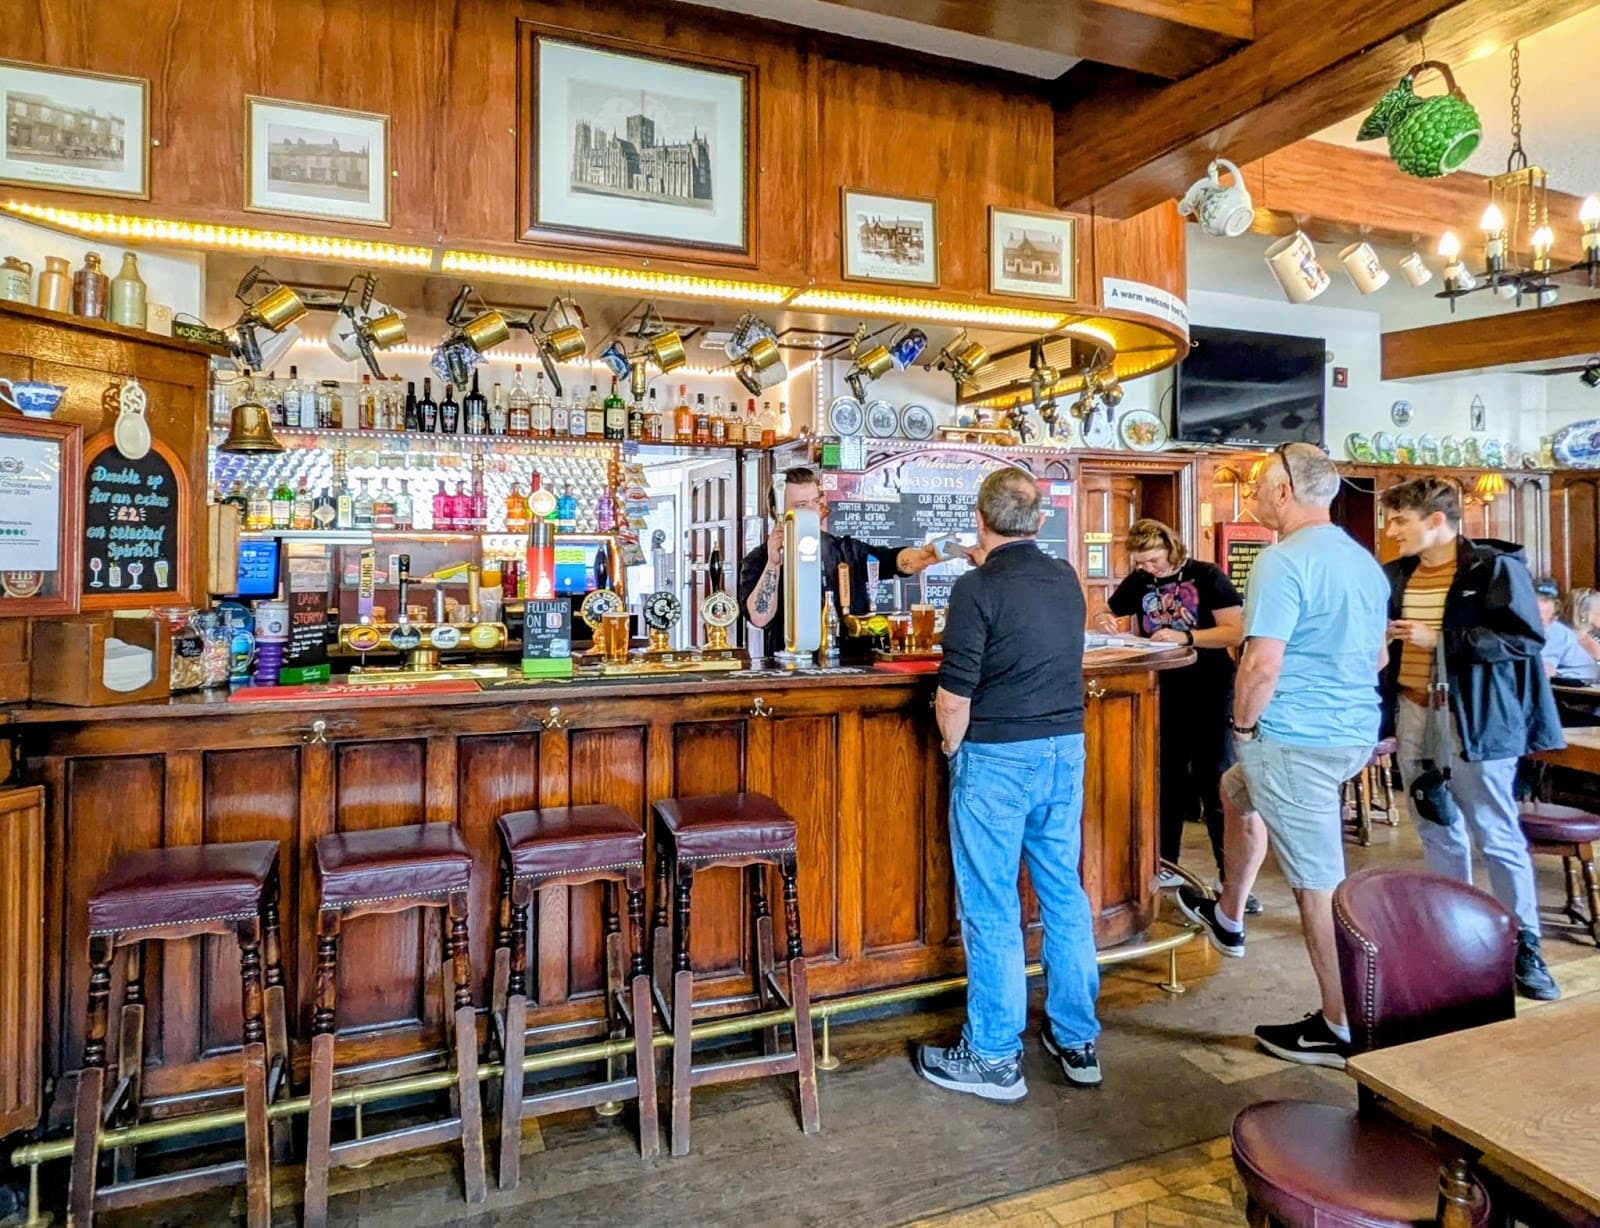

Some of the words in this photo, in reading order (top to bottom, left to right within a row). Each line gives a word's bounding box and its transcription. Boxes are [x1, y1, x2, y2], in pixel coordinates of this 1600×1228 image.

[1112, 288, 1118, 297] A
[1120, 290, 1144, 301] warm
[147, 475, 164, 490] up
[117, 506, 140, 521] £2
[361, 563, 373, 599] CARLING
[526, 614, 542, 628] ON
